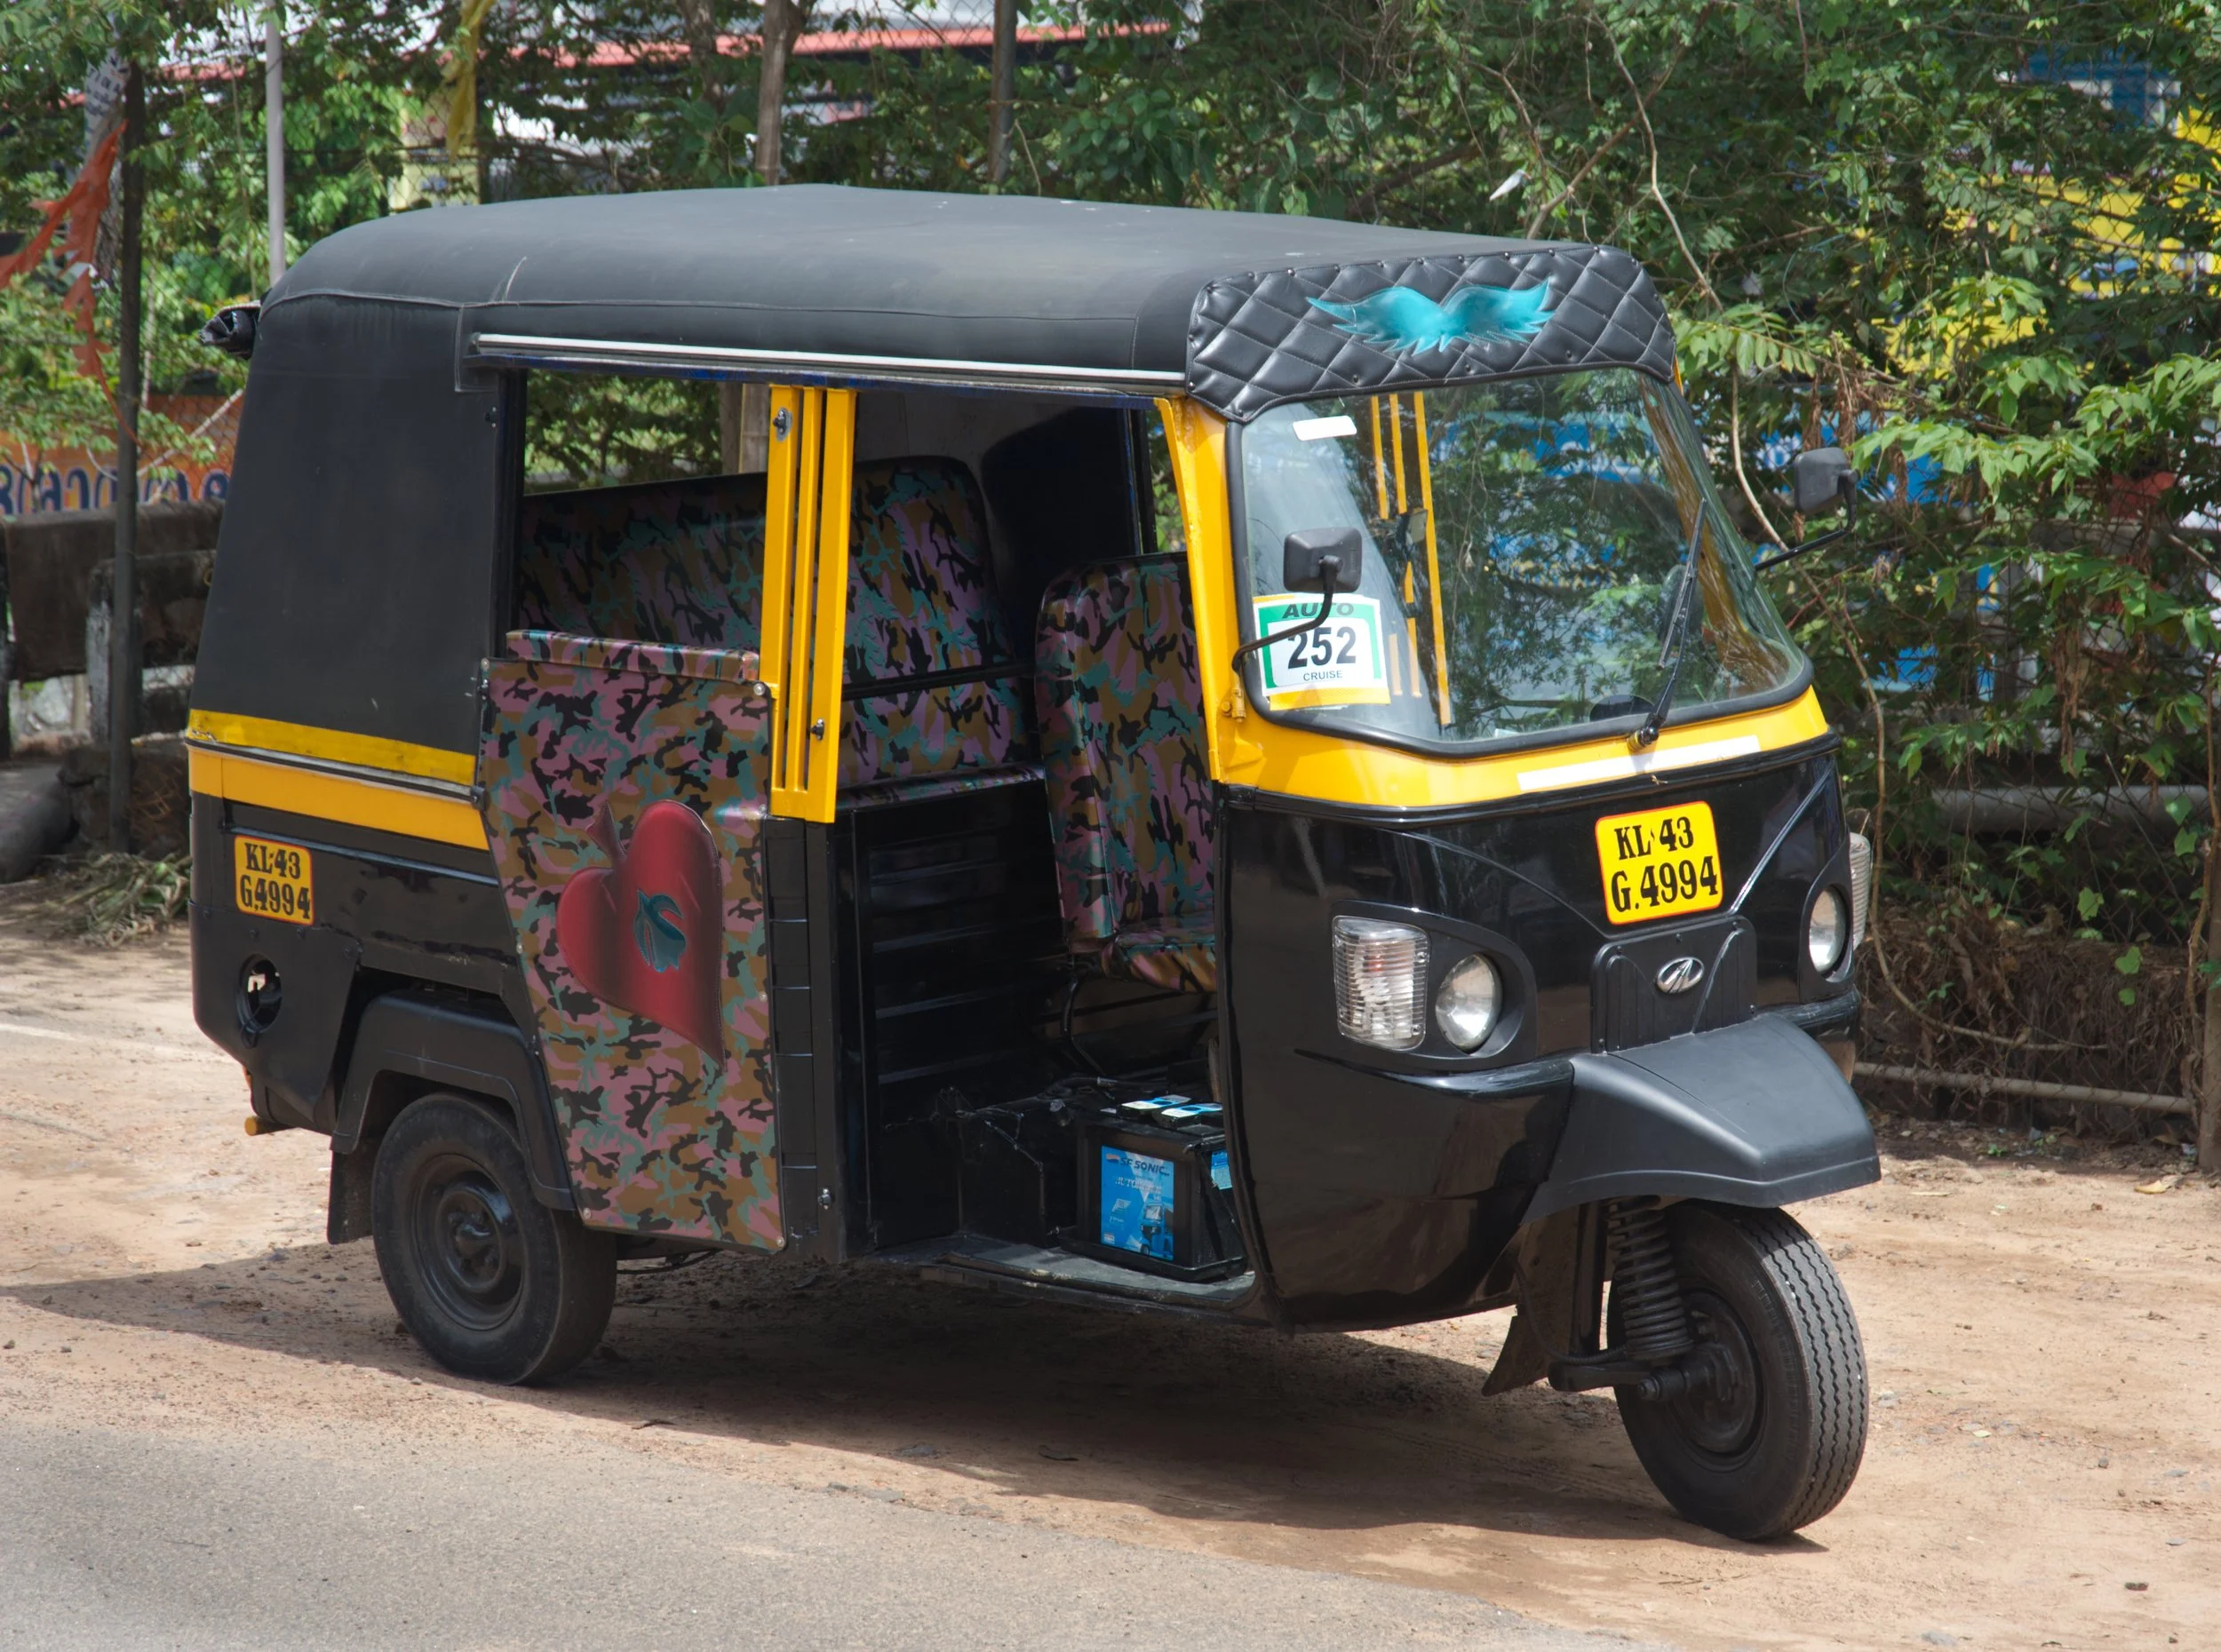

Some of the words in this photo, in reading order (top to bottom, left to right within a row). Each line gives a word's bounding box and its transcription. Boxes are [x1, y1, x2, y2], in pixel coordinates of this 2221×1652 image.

[1282, 602, 1354, 619] AUO
[1288, 625, 1357, 670] 252
[1303, 670, 1343, 681] CRUISE
